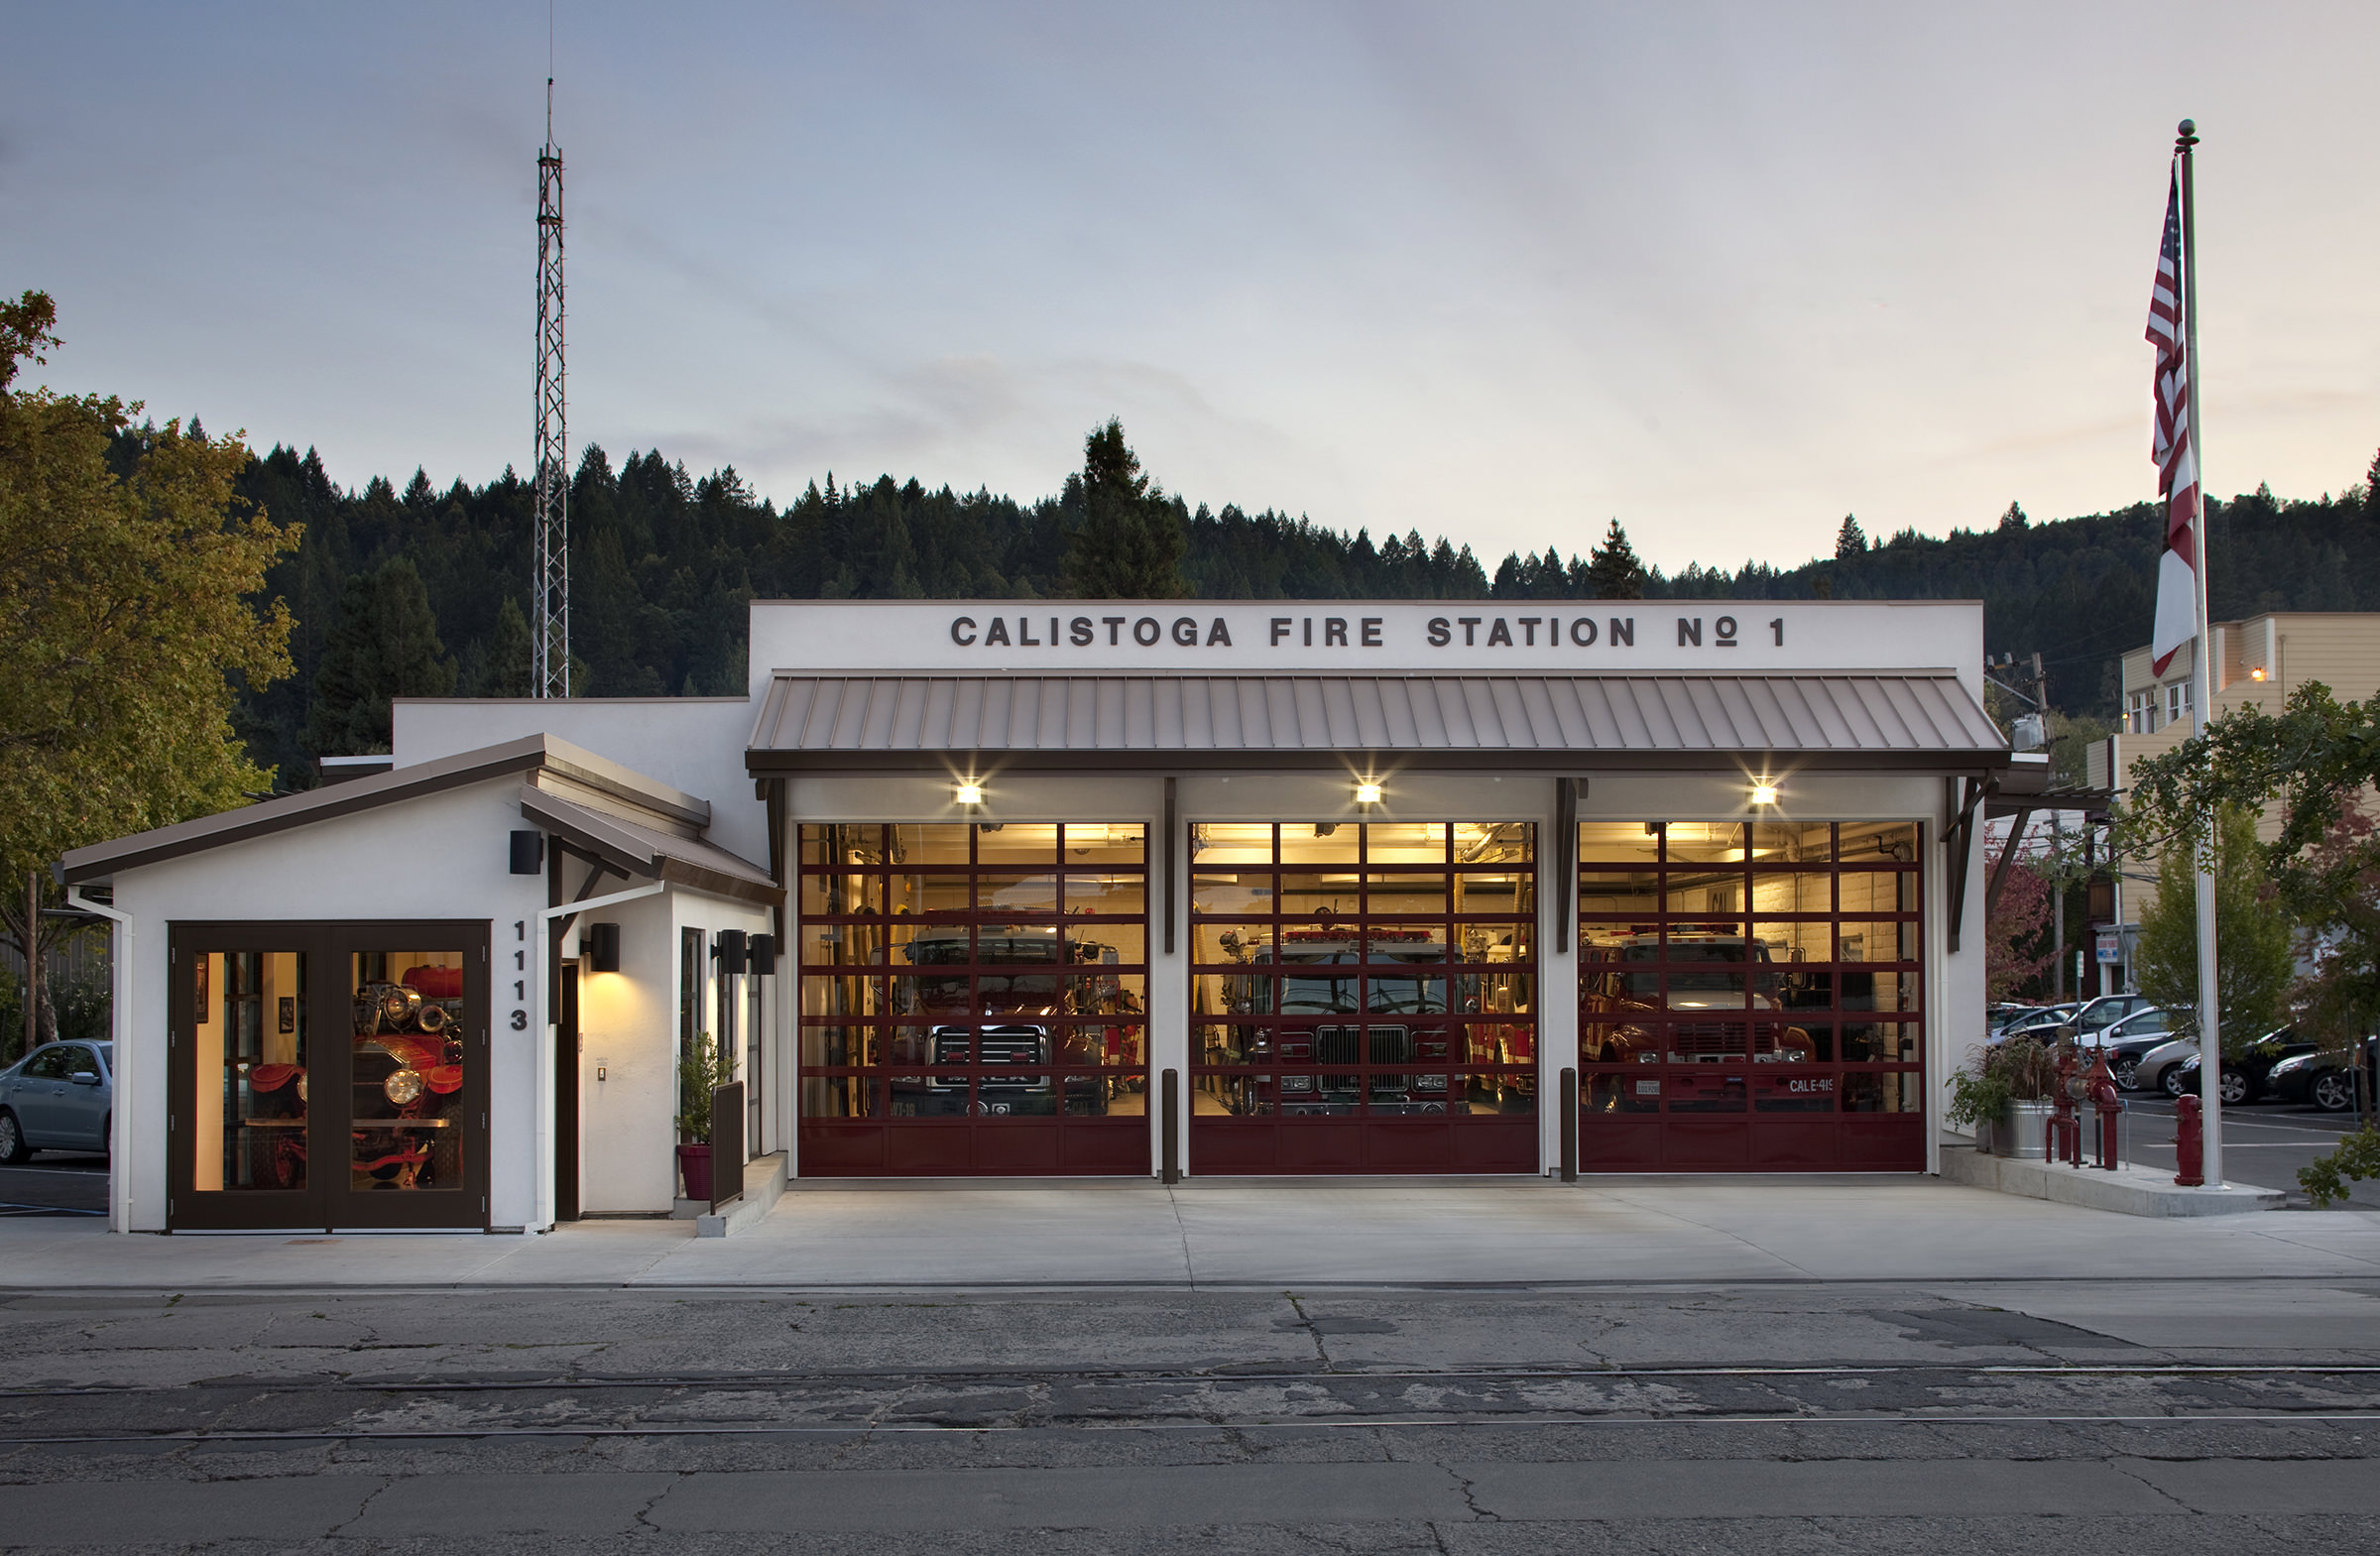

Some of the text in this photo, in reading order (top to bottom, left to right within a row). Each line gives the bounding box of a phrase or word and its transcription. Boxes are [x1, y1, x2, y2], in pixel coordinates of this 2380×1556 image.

[950, 616, 1233, 647] CALISTOGA
[1270, 617, 1383, 647] FIRE
[1427, 617, 1634, 647] STATION
[1769, 618, 1783, 647] 1
[510, 920, 528, 1031] 1113
[1789, 1080, 1810, 1092] CAL
